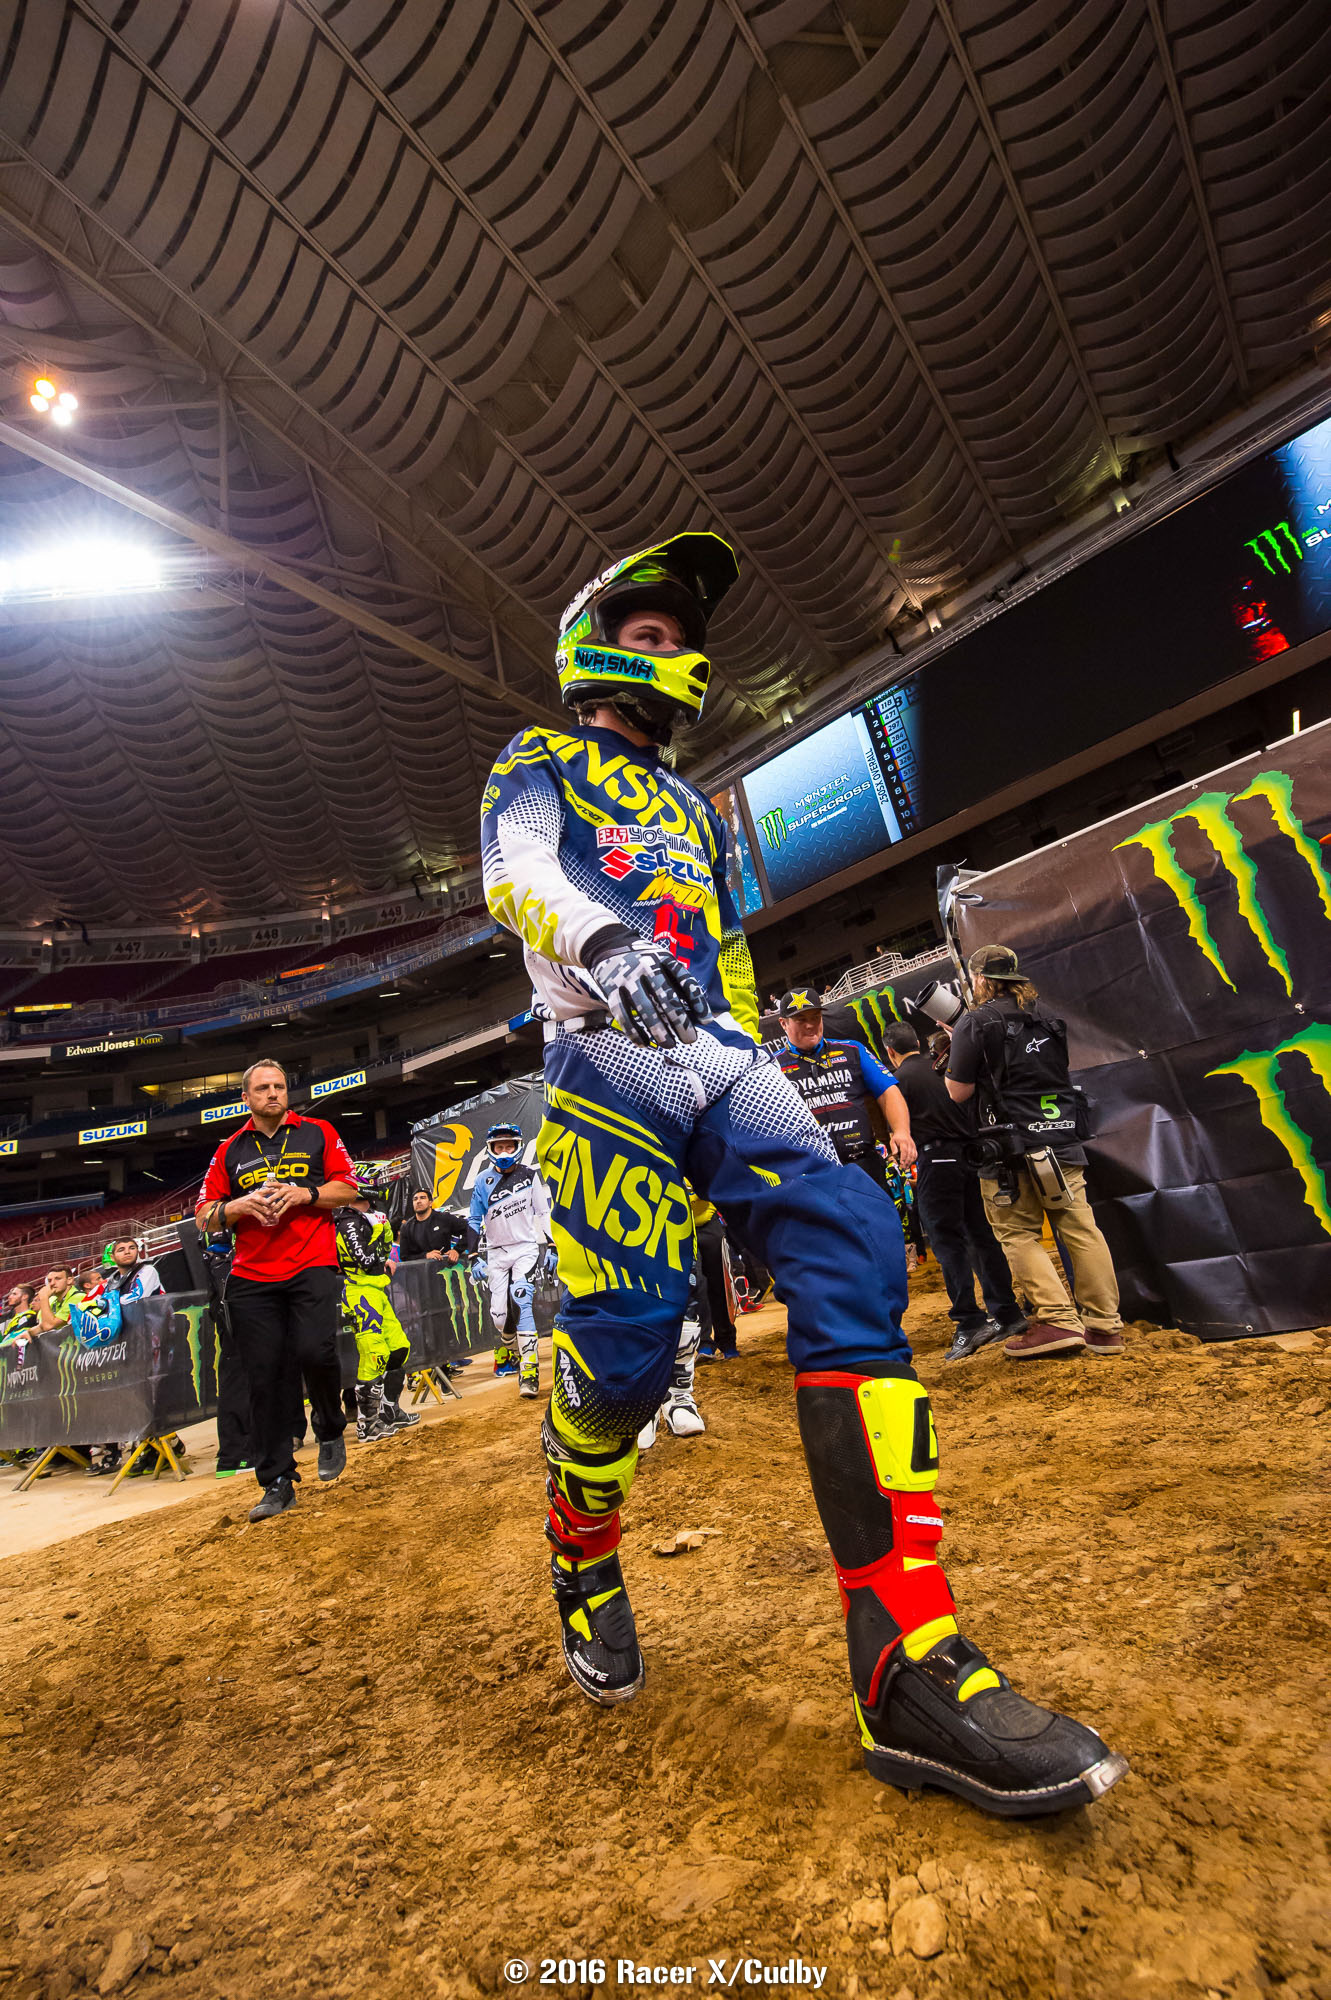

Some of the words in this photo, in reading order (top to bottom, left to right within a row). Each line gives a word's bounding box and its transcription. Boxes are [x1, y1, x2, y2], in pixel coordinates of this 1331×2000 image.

[880, 699, 893, 710] 118
[872, 720, 880, 728] 2
[884, 709, 897, 720] 471
[876, 731, 883, 739] 3
[888, 720, 900, 732] 297
[891, 732, 904, 743] 284
[883, 753, 891, 761] 5
[895, 743, 908, 754] 90
[865, 748, 881, 780] OVERALL
[887, 764, 894, 772] 6
[890, 775, 897, 784] 7
[875, 780, 889, 805] 250SX
[894, 787, 902, 795] 8
[787, 781, 871, 831] SUPERCROSS
[900, 810, 911, 820] 10
[637, 873, 707, 908] MAD
[380, 907, 401, 919] 449
[255, 929, 279, 941] 448
[114, 942, 141, 954] 447
[240, 1008, 261, 1022] DAN
[263, 1002, 299, 1018] REEVES
[313, 1073, 364, 1096] SUZUKI
[798, 1069, 853, 1091] YAMAHA
[1041, 1094, 1061, 1120] 5
[82, 1123, 144, 1142] SUZUKI
[238, 1163, 309, 1189] GEICO
[490, 1178, 532, 1202] seven
[544, 1130, 692, 1272] ANSR
[84, 1370, 119, 1385] ENERGY
[558, 1348, 582, 1408] ANSR
